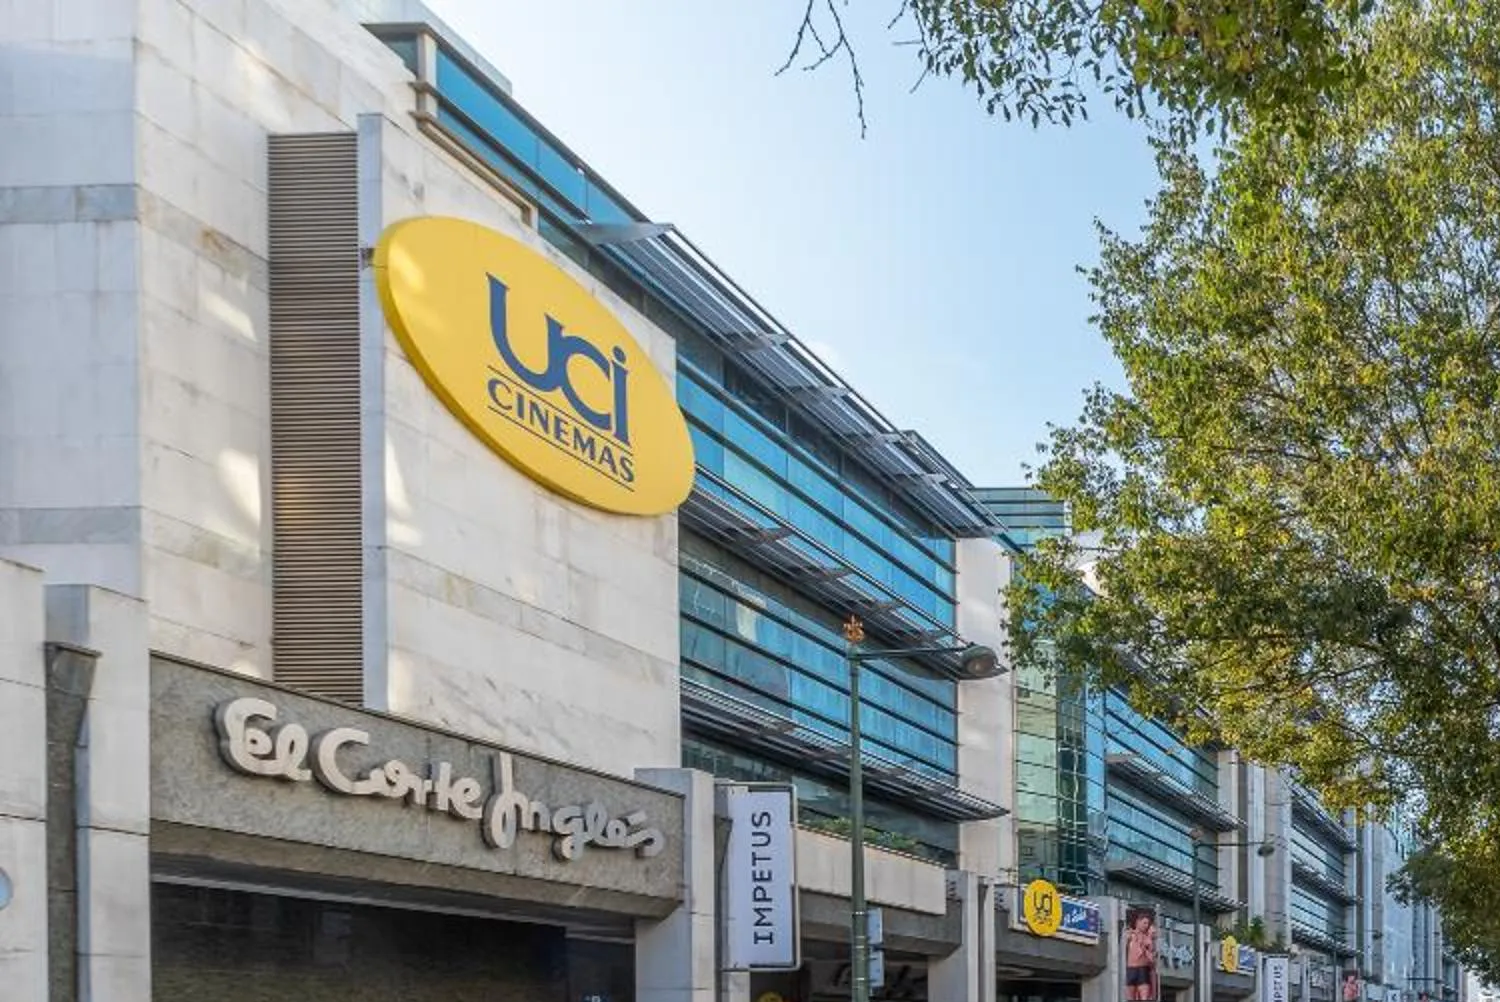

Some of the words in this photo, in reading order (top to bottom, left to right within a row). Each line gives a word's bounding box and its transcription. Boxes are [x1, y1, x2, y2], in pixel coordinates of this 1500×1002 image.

[487, 378, 635, 483] CINEMAS
[218, 697, 312, 781] El
[317, 727, 483, 819] Corte
[751, 811, 774, 945] IMPETUS
